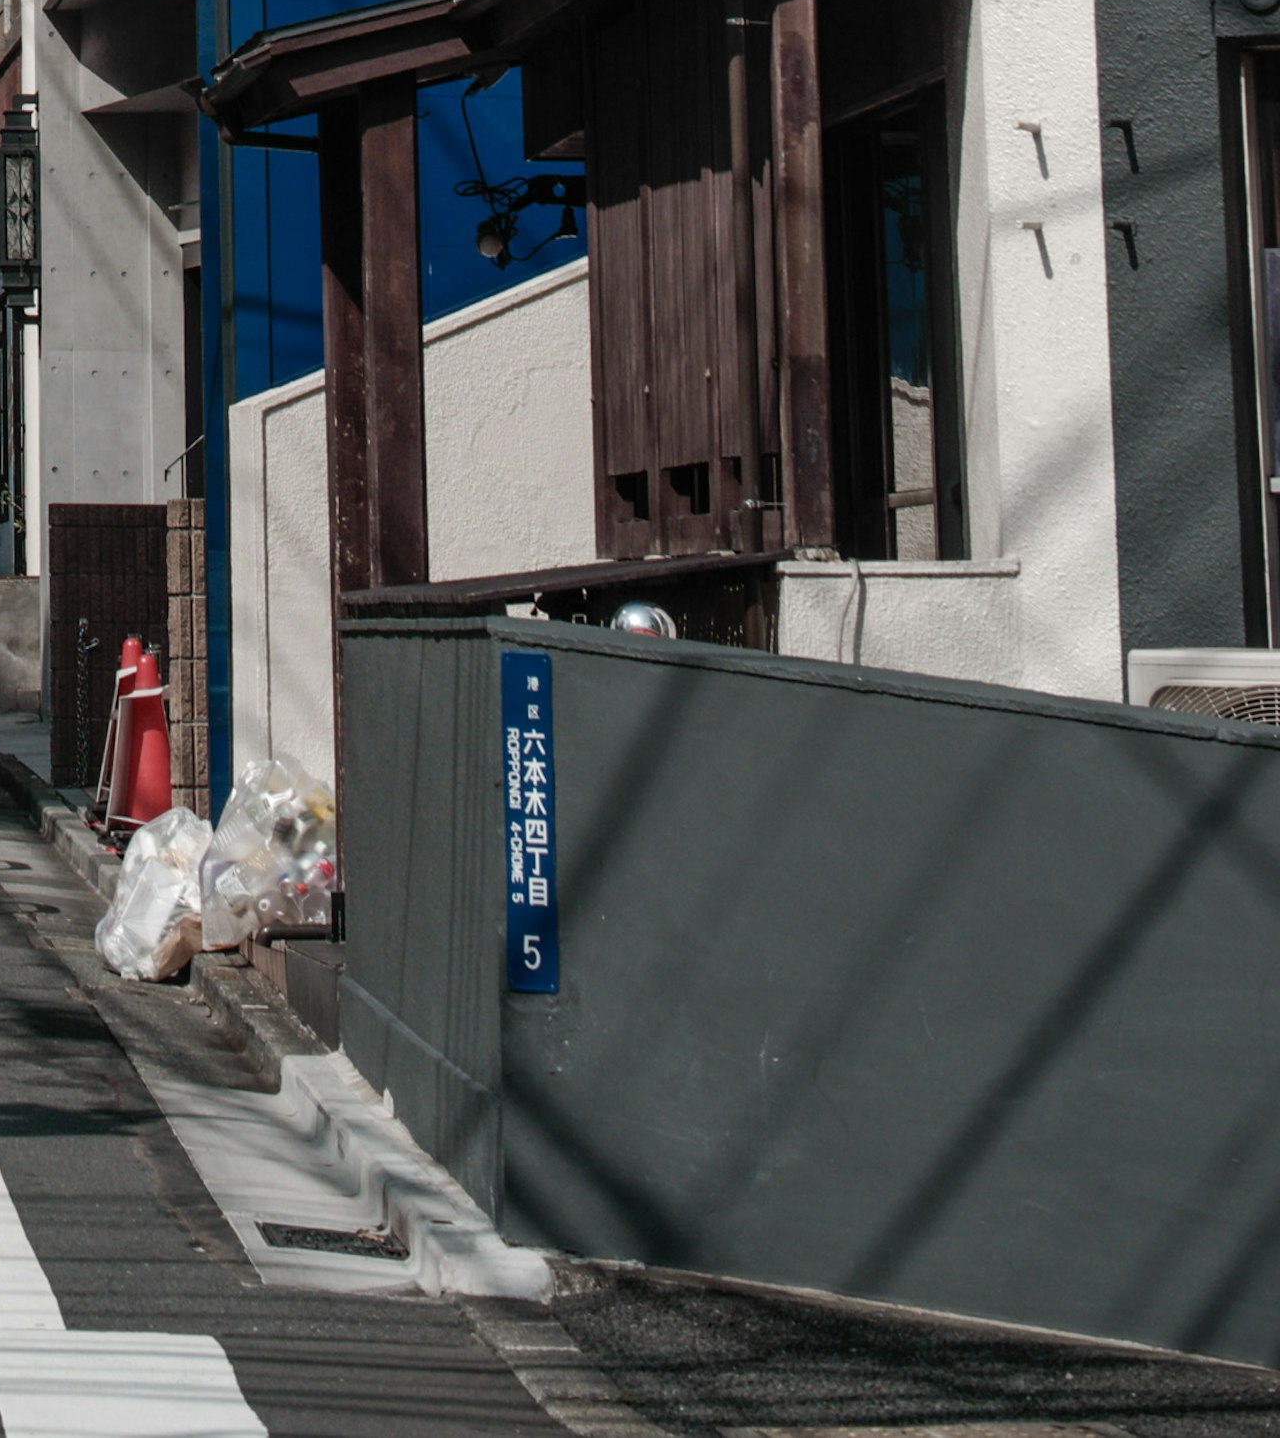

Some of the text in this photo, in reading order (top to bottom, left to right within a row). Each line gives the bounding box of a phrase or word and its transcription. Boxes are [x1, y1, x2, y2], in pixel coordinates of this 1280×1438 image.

[506, 726, 525, 904] ROPPONGI 4-CHOME 5
[522, 728, 549, 908] 六本木四丁目
[522, 934, 541, 971] 5
